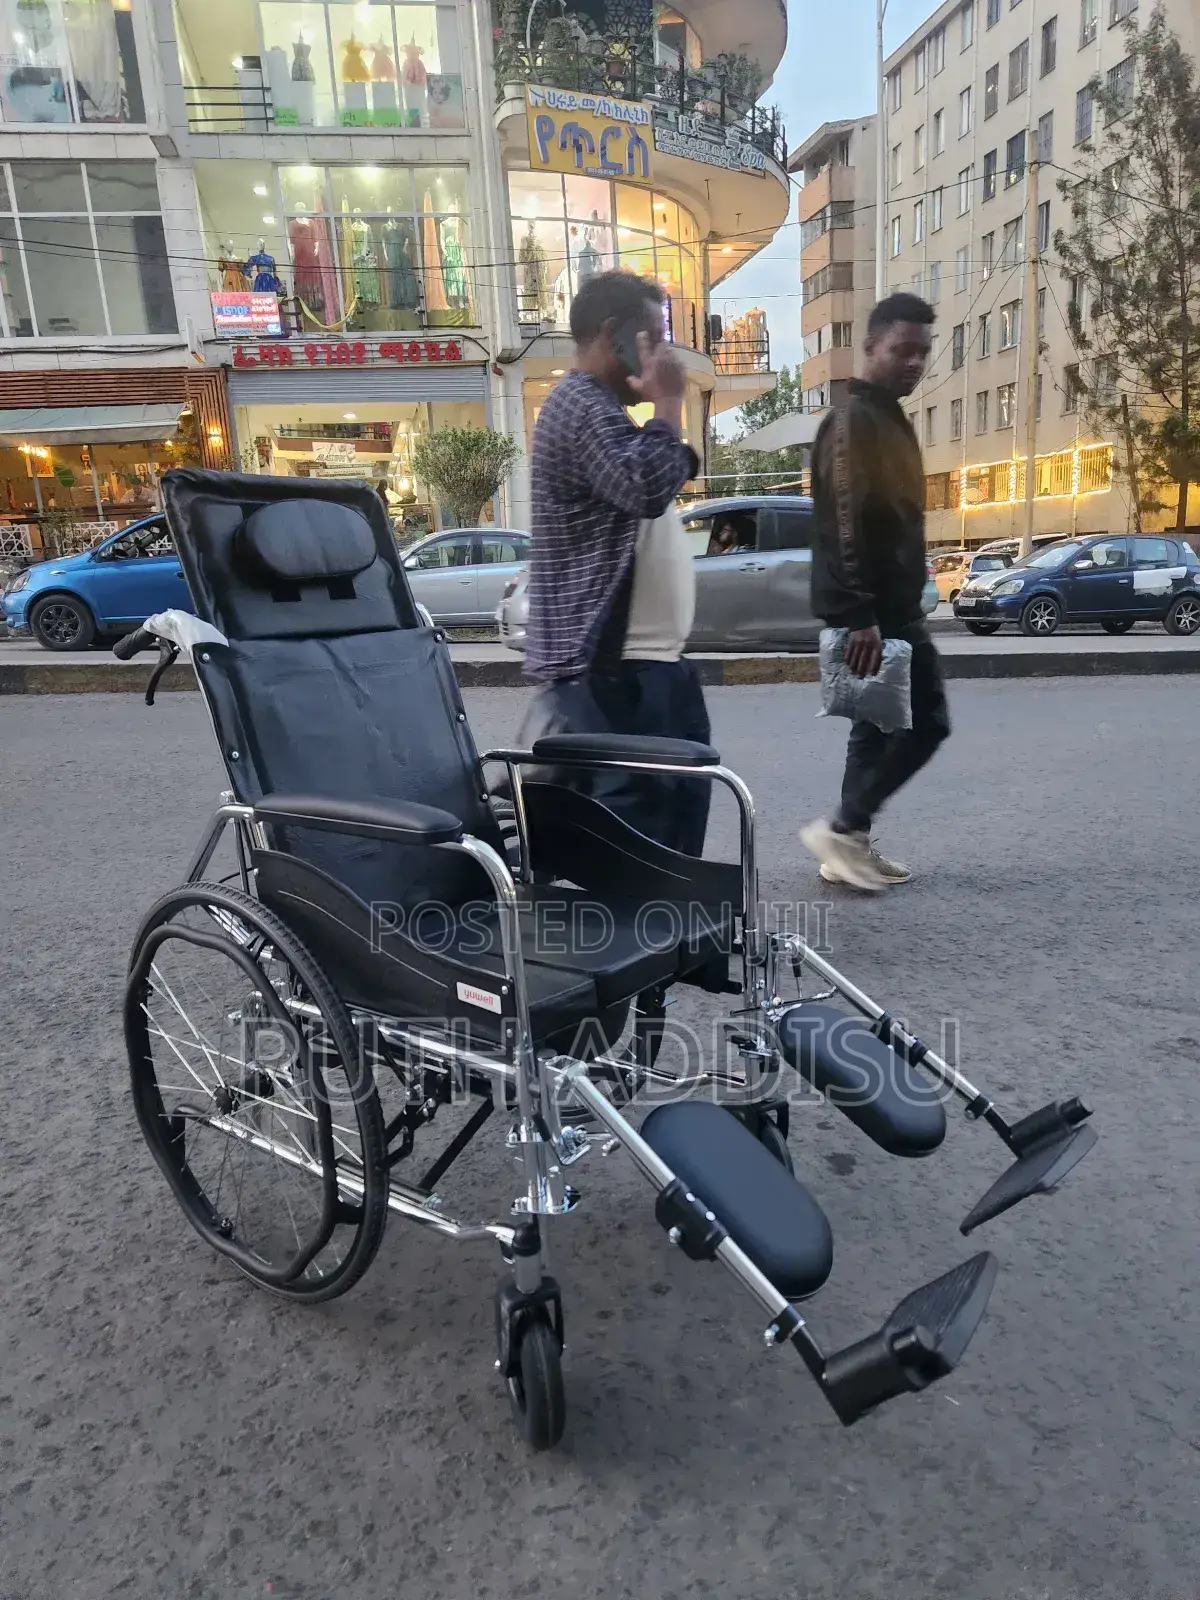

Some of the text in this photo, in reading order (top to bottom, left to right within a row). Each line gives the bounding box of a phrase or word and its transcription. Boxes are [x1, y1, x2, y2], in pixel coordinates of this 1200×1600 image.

[534, 114, 649, 178] የጥርስ
[741, 144, 766, 169] Spa
[464, 989, 494, 1005] yuwell
